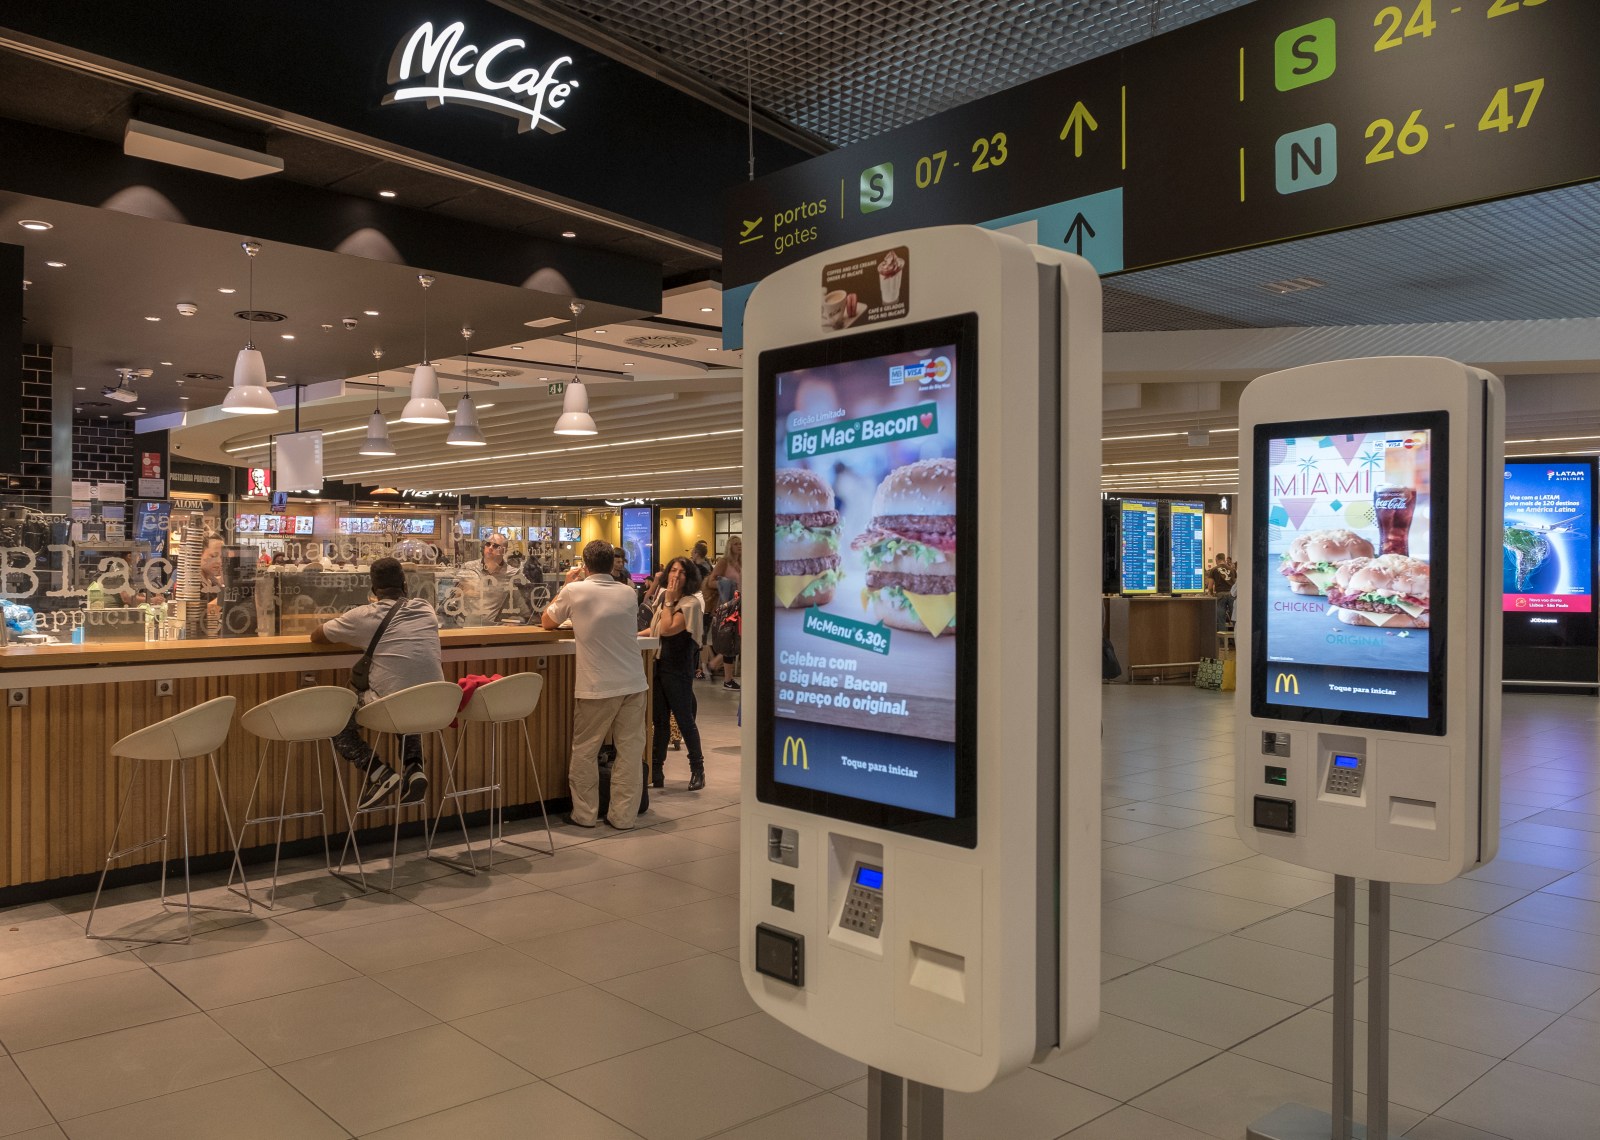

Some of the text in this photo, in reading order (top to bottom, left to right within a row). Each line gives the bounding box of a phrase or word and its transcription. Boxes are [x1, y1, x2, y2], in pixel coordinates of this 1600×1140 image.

[1291, 34, 1319, 76] S
[1373, 0, 1437, 53] 24
[395, 21, 580, 129] McCafé
[1290, 136, 1322, 181] N
[1364, 109, 1429, 165] 26
[1478, 78, 1545, 133] 47
[869, 173, 884, 203] S
[915, 150, 948, 189] 07
[971, 132, 1008, 173] 23
[774, 199, 827, 232] portas
[774, 226, 818, 255] gates
[907, 368, 922, 377] VISA
[793, 407, 846, 427] Edição Limitada
[791, 432, 818, 454] Big
[861, 414, 918, 441] Bacon
[1273, 469, 1370, 497] MIAMI
[174, 499, 204, 509] ALOMA
[1273, 601, 1324, 613] CHICKEN
[779, 650, 857, 671] Celebra com
[779, 671, 787, 682] o
[789, 668, 810, 687] Big
[844, 675, 888, 694] Bacon
[1328, 684, 1397, 696] Toque para iniciar
[778, 688, 910, 716] ao preço do original.
[841, 755, 919, 779] Toque para iniciar
